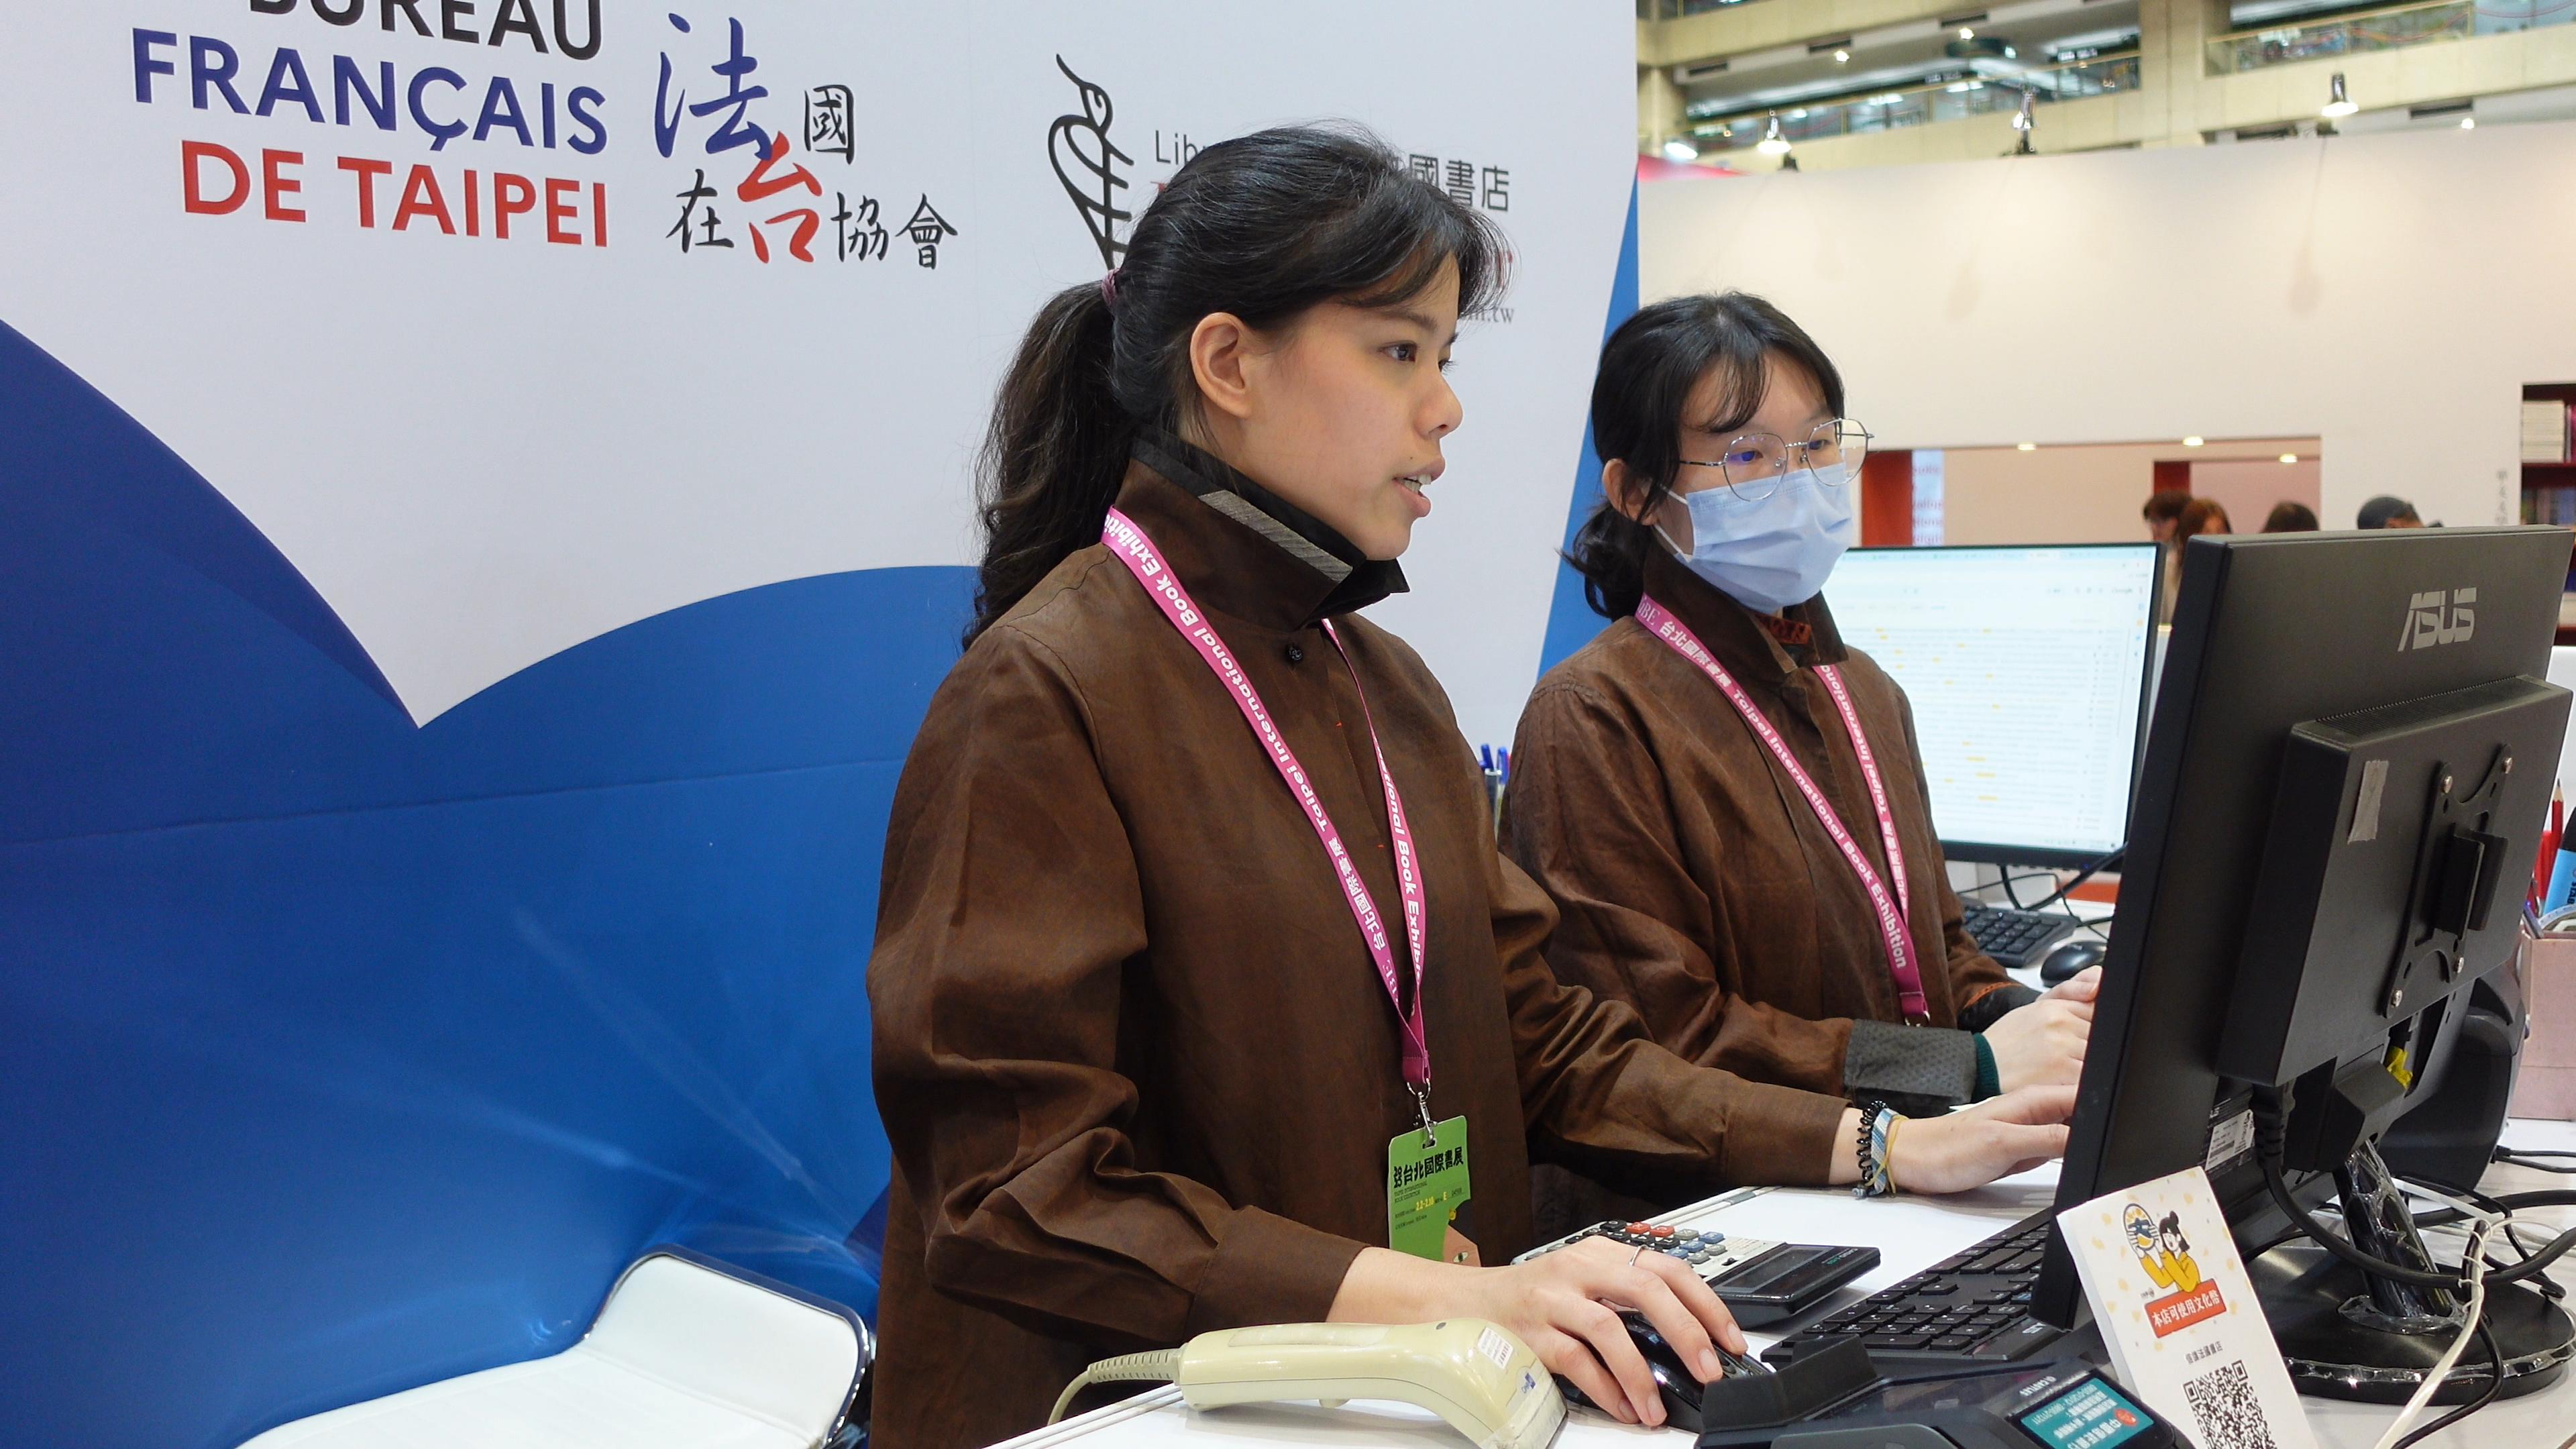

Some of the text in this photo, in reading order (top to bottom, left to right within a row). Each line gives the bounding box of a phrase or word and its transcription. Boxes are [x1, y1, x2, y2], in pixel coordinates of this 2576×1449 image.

[132, 28, 608, 155] FRANÇAIS
[1155, 129, 1200, 165] Lib
[182, 140, 608, 248] DE TAIPEI
[1409, 154, 1509, 211] 國書店
[1156, 574, 1199, 627] Book
[2397, 587, 2477, 652] ASUS
[1659, 621, 1731, 688] 台北國際書展
[1193, 627, 1291, 763] International
[1819, 665, 1870, 761] Internationa
[1286, 765, 1327, 832] Taipei
[1733, 689, 1907, 968] Taipei International Book Exhibition
[1328, 837, 1385, 951] 台北國際書展
[1397, 839, 1417, 895] Book
[2151, 1289, 2220, 1328] 本店可使用文化幣
